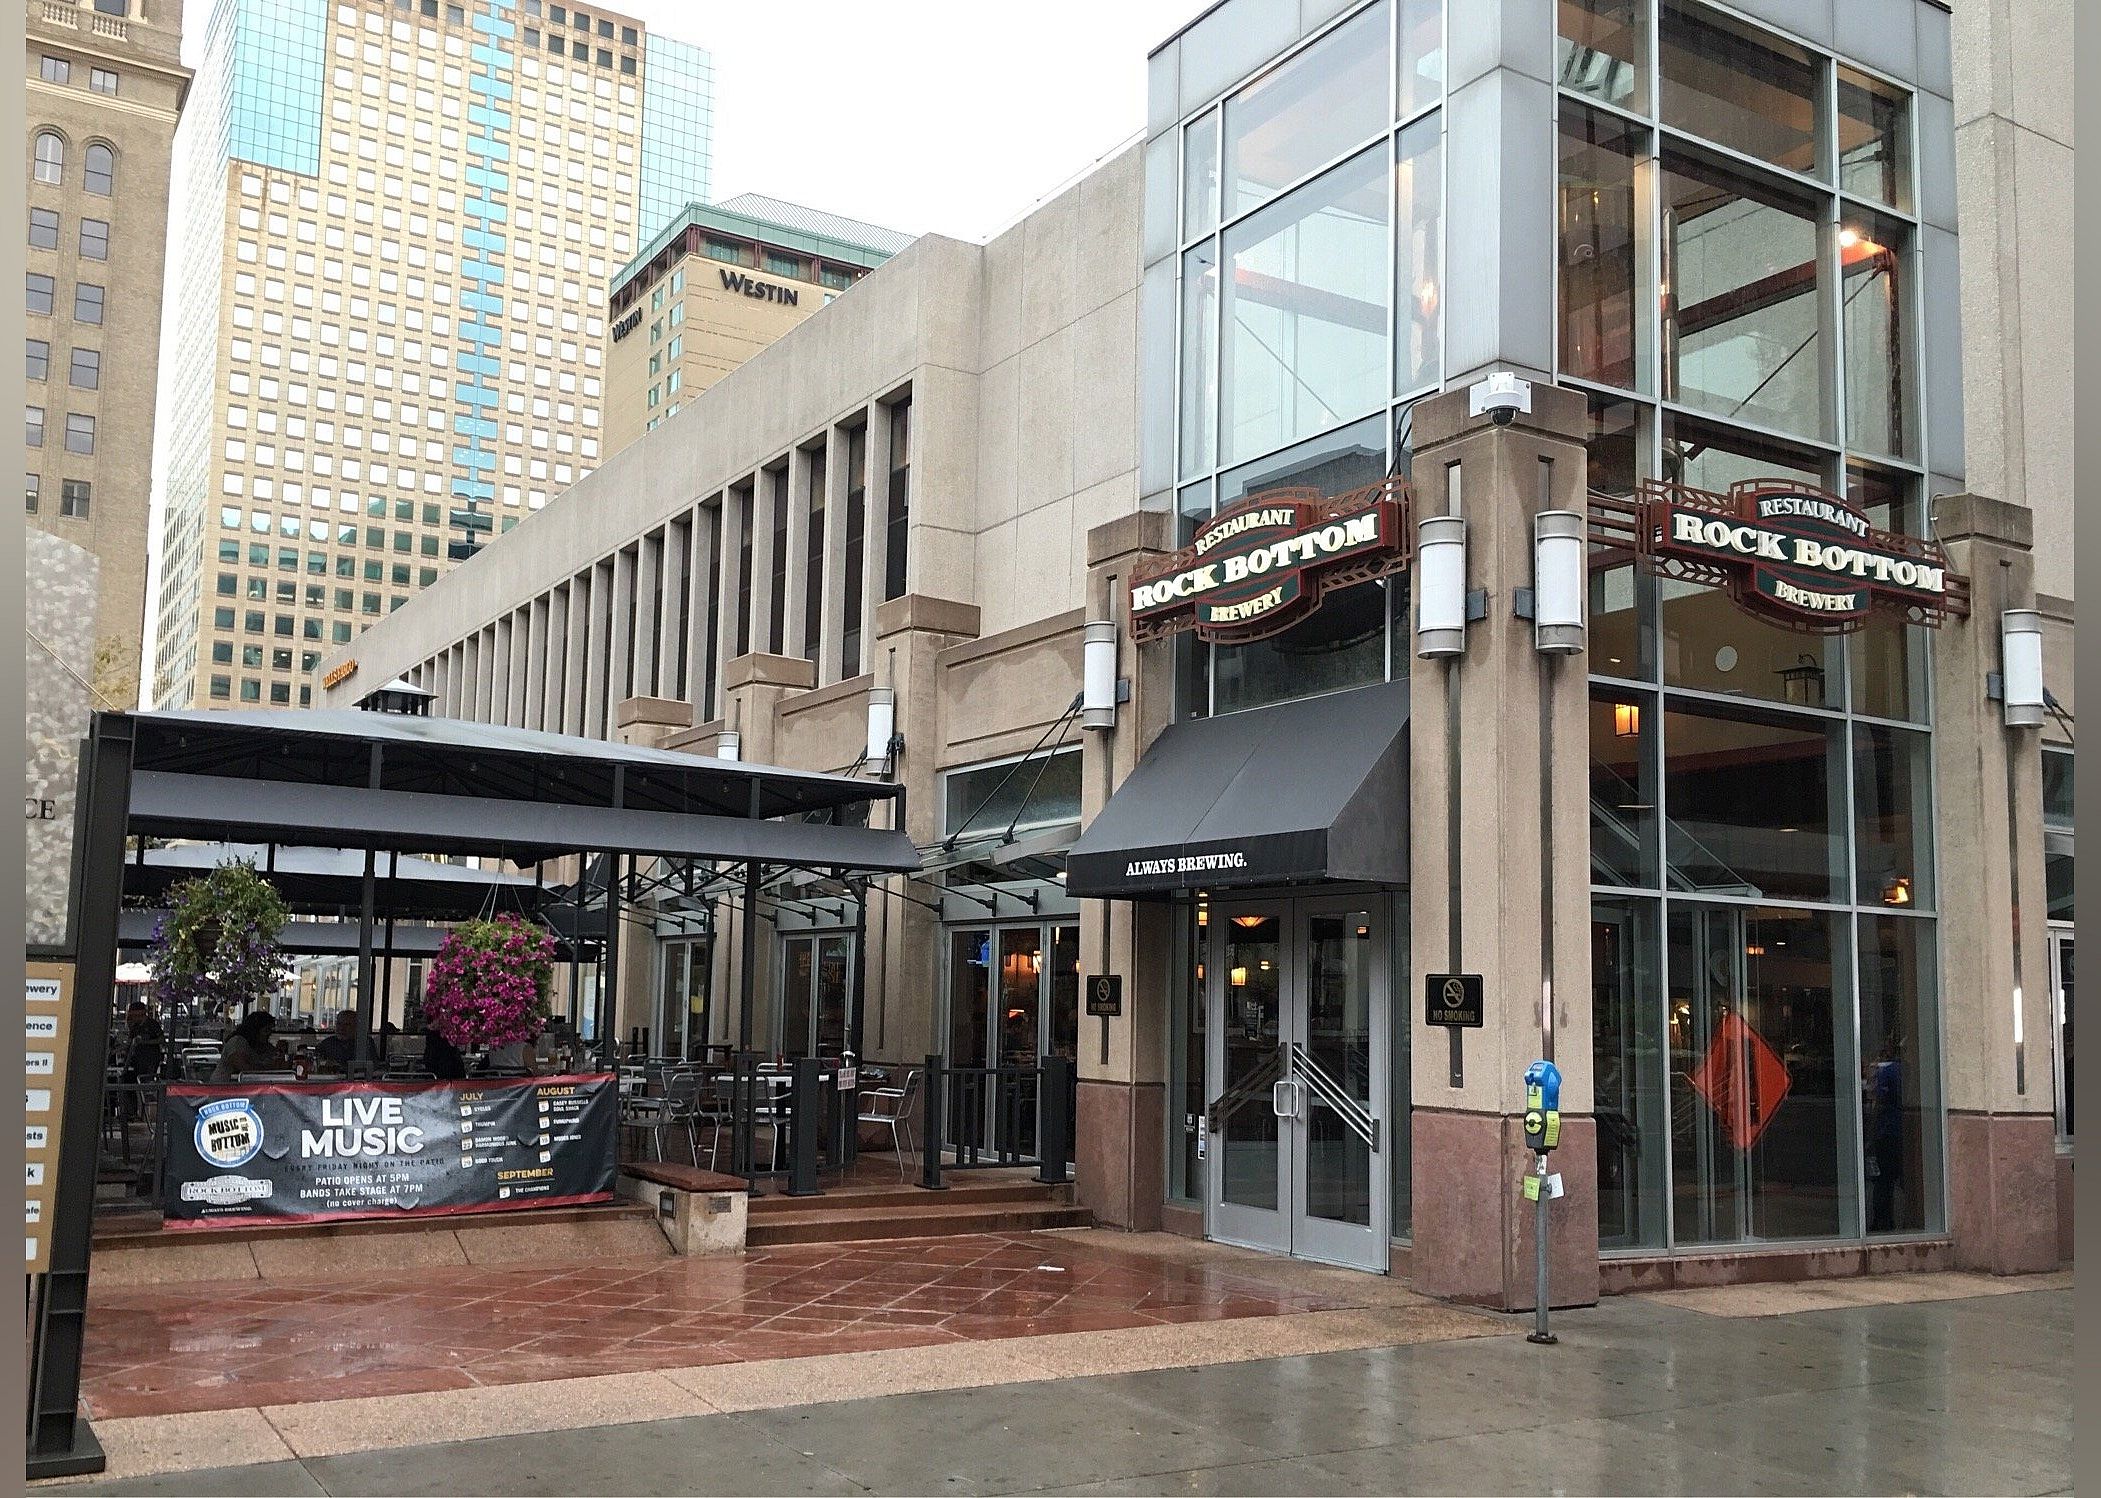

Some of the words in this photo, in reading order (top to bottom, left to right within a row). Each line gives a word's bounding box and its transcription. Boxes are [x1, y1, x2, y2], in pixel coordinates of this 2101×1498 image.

[720, 268, 798, 306] WESTIN
[1758, 497, 1869, 537] RESTAURANT
[1195, 509, 1295, 556] RESTAURANT
[1131, 564, 1220, 611] ROCK
[1222, 513, 1378, 583] BOTTOM
[1673, 513, 1788, 561] ROCK
[1793, 538, 1946, 592] BOTTOM
[1210, 586, 1283, 622] BREWERY
[1774, 580, 1857, 611] BREWERY
[1125, 859, 1175, 876] ALWAYS
[1177, 852, 1248, 872] BREWING.
[1433, 1009, 1443, 1021] NO
[1444, 1009, 1475, 1022] SMOKING
[460, 1092, 483, 1101] JULY
[537, 1087, 576, 1096] AUGUST
[322, 1097, 404, 1126] LIVE
[208, 1118, 239, 1135] MUSIC
[301, 1126, 424, 1158] MUSIC
[317, 1163, 348, 1171] FRIDAY
[353, 1161, 380, 1170] NIGHT
[497, 1168, 553, 1180] SEPTEMBER
[300, 1188, 331, 1199] BANDS
[334, 1186, 356, 1197] TAKE
[359, 1185, 387, 1196] STAGE
[389, 1185, 401, 1194] AT
[404, 1183, 423, 1193] 7PM
[315, 1175, 342, 1186] PATIO
[343, 1175, 373, 1185] OPENS
[376, 1174, 388, 1183] AT
[389, 1173, 410, 1183] 5PM
[326, 1199, 340, 1208] (no
[346, 1198, 366, 1207] cover
[367, 1196, 398, 1207] charge)
